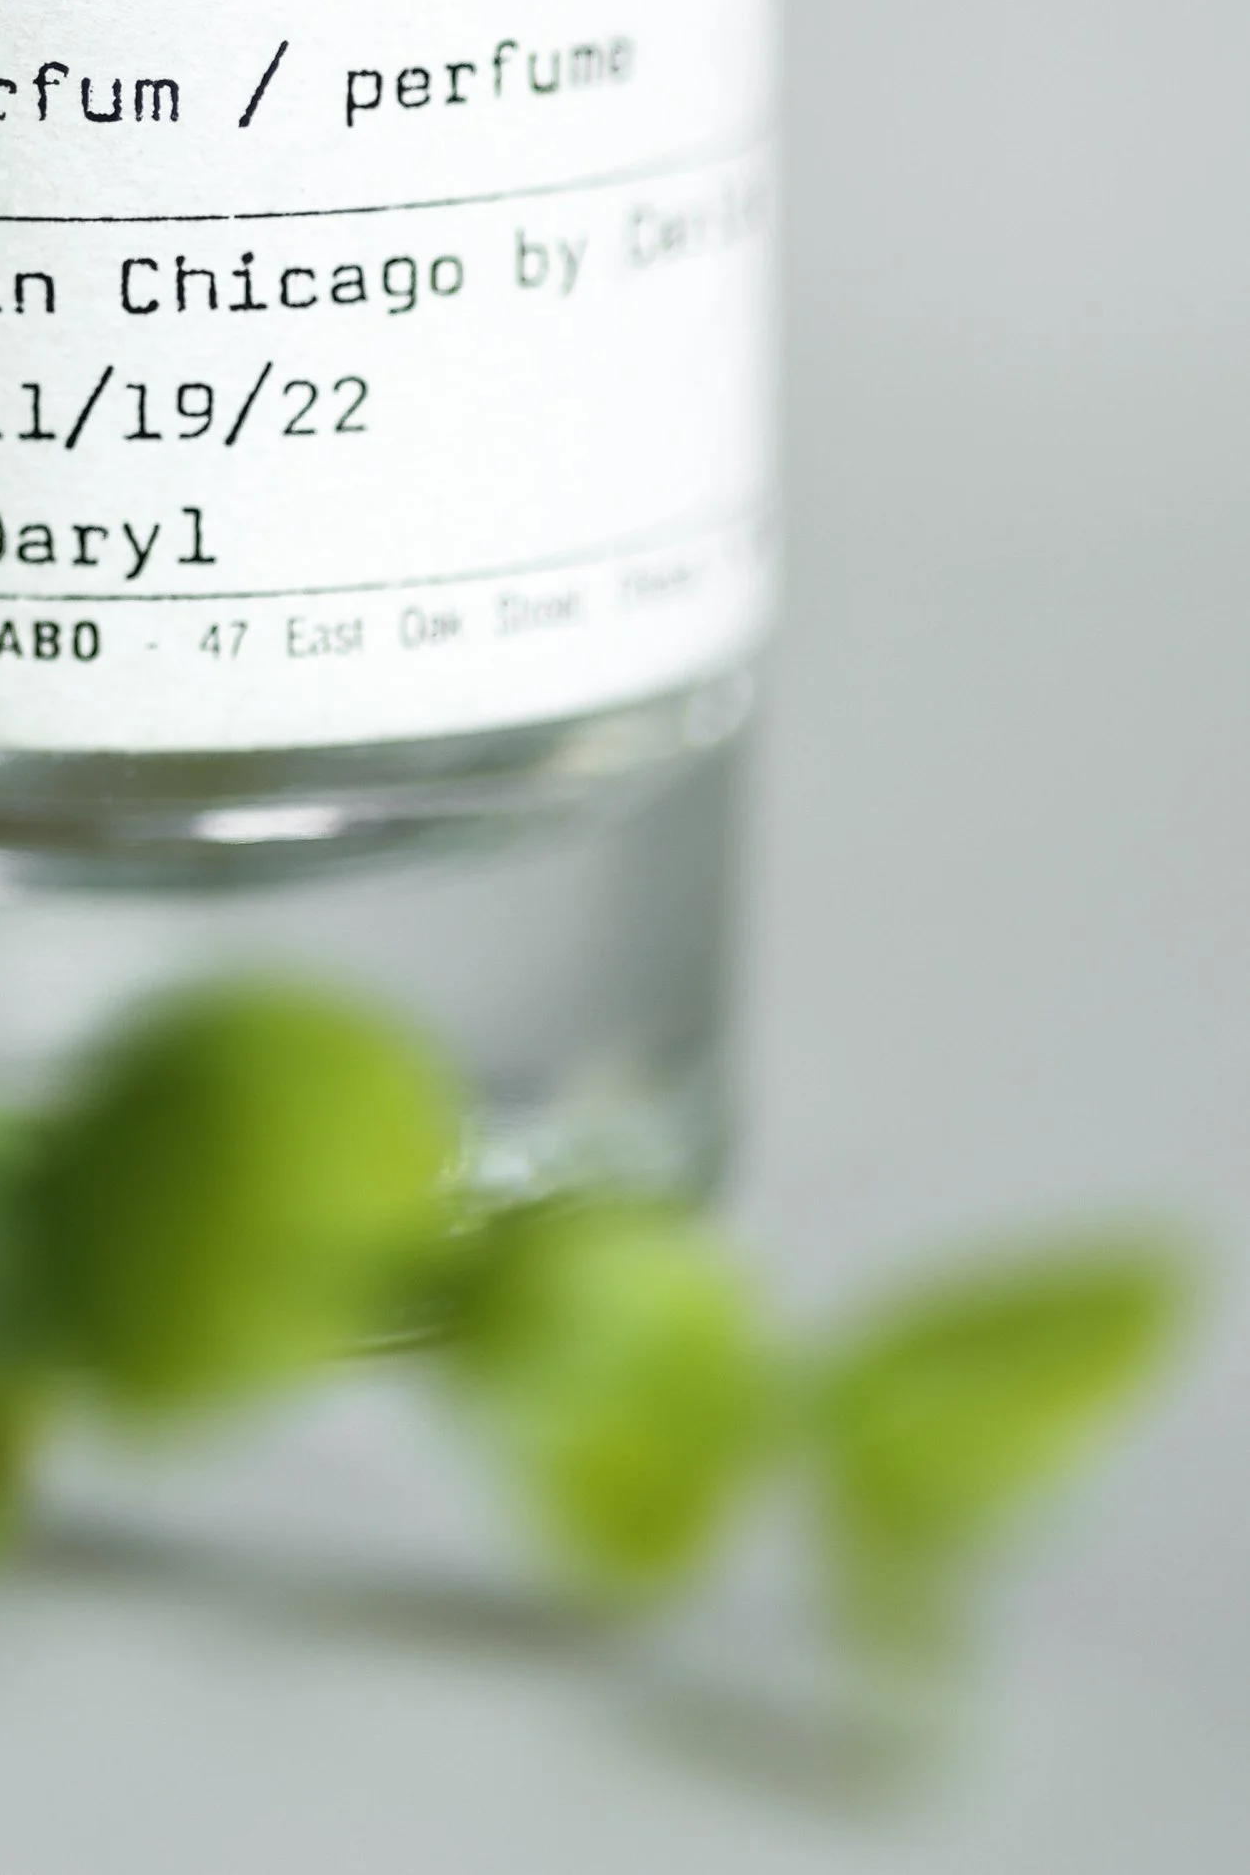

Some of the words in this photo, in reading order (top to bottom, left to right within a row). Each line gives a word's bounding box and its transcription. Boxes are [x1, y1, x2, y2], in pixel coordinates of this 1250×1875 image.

[237, 40, 290, 129] /
[344, 37, 637, 130] perfume
[119, 248, 466, 318] Chicago
[514, 228, 588, 297] by
[198, 617, 250, 661] 47
[284, 613, 365, 661] East
